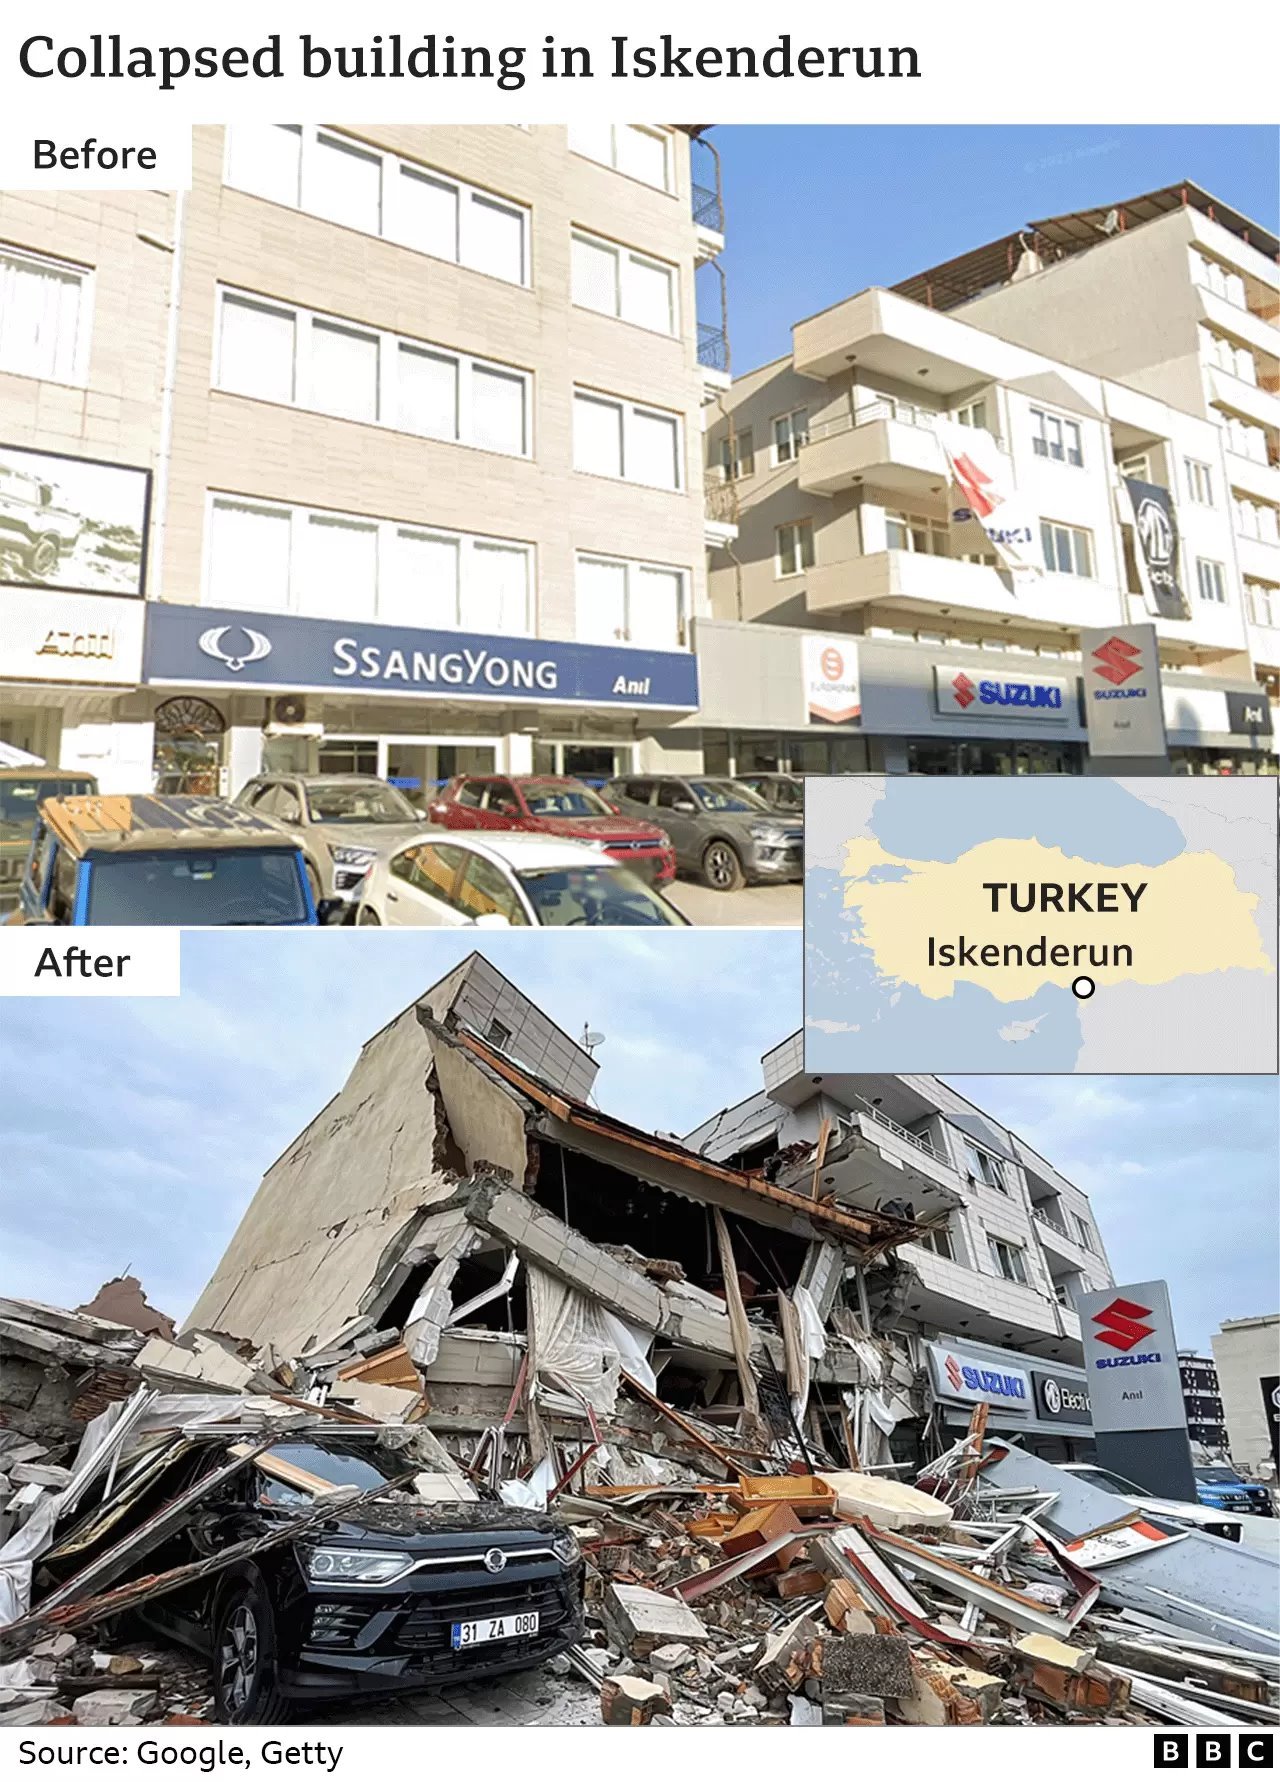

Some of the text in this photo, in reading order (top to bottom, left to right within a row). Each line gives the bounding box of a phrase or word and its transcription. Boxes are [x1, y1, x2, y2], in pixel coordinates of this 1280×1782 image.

[979, 680, 1062, 709] SUZUKI
[1094, 688, 1147, 700] SUZUKI
[1096, 1353, 1162, 1369] SUZUKI
[961, 1365, 1026, 1399] SUZUKI
[462, 1624, 477, 1643] 31
[489, 1619, 505, 1638] ZA
[515, 1614, 537, 1633] 080
